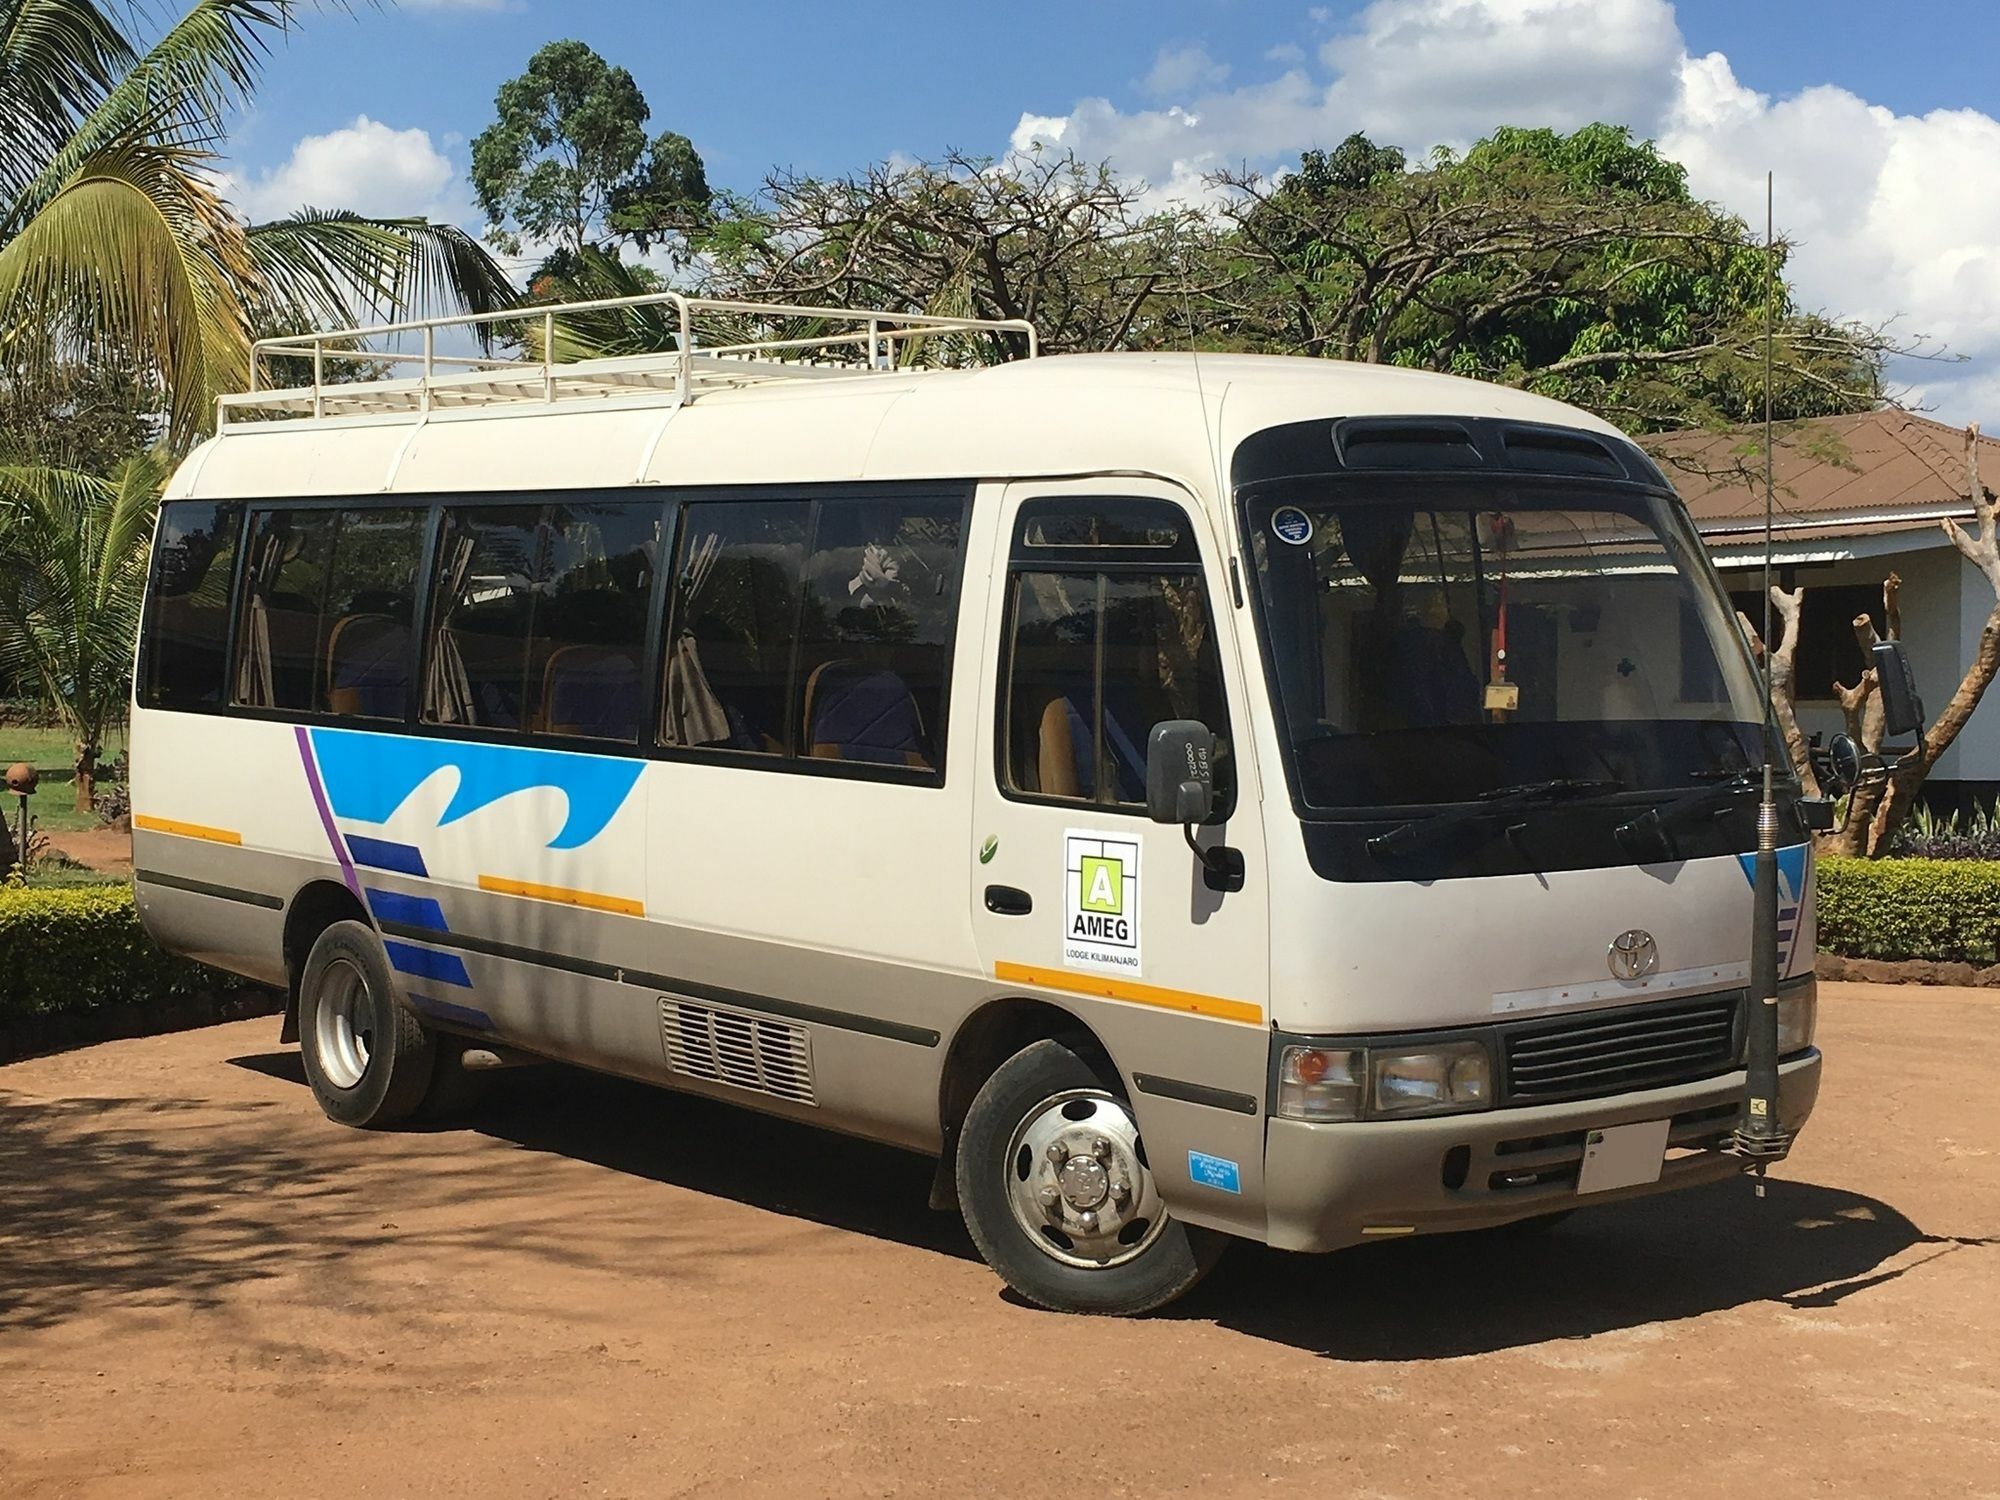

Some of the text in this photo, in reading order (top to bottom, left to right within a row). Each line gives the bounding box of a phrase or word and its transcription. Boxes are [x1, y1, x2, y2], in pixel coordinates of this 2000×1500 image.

[1087, 864, 1117, 908] A
[1073, 914, 1128, 941] AMEG
[1066, 949, 1138, 967] LODGE KILIMANJARO
